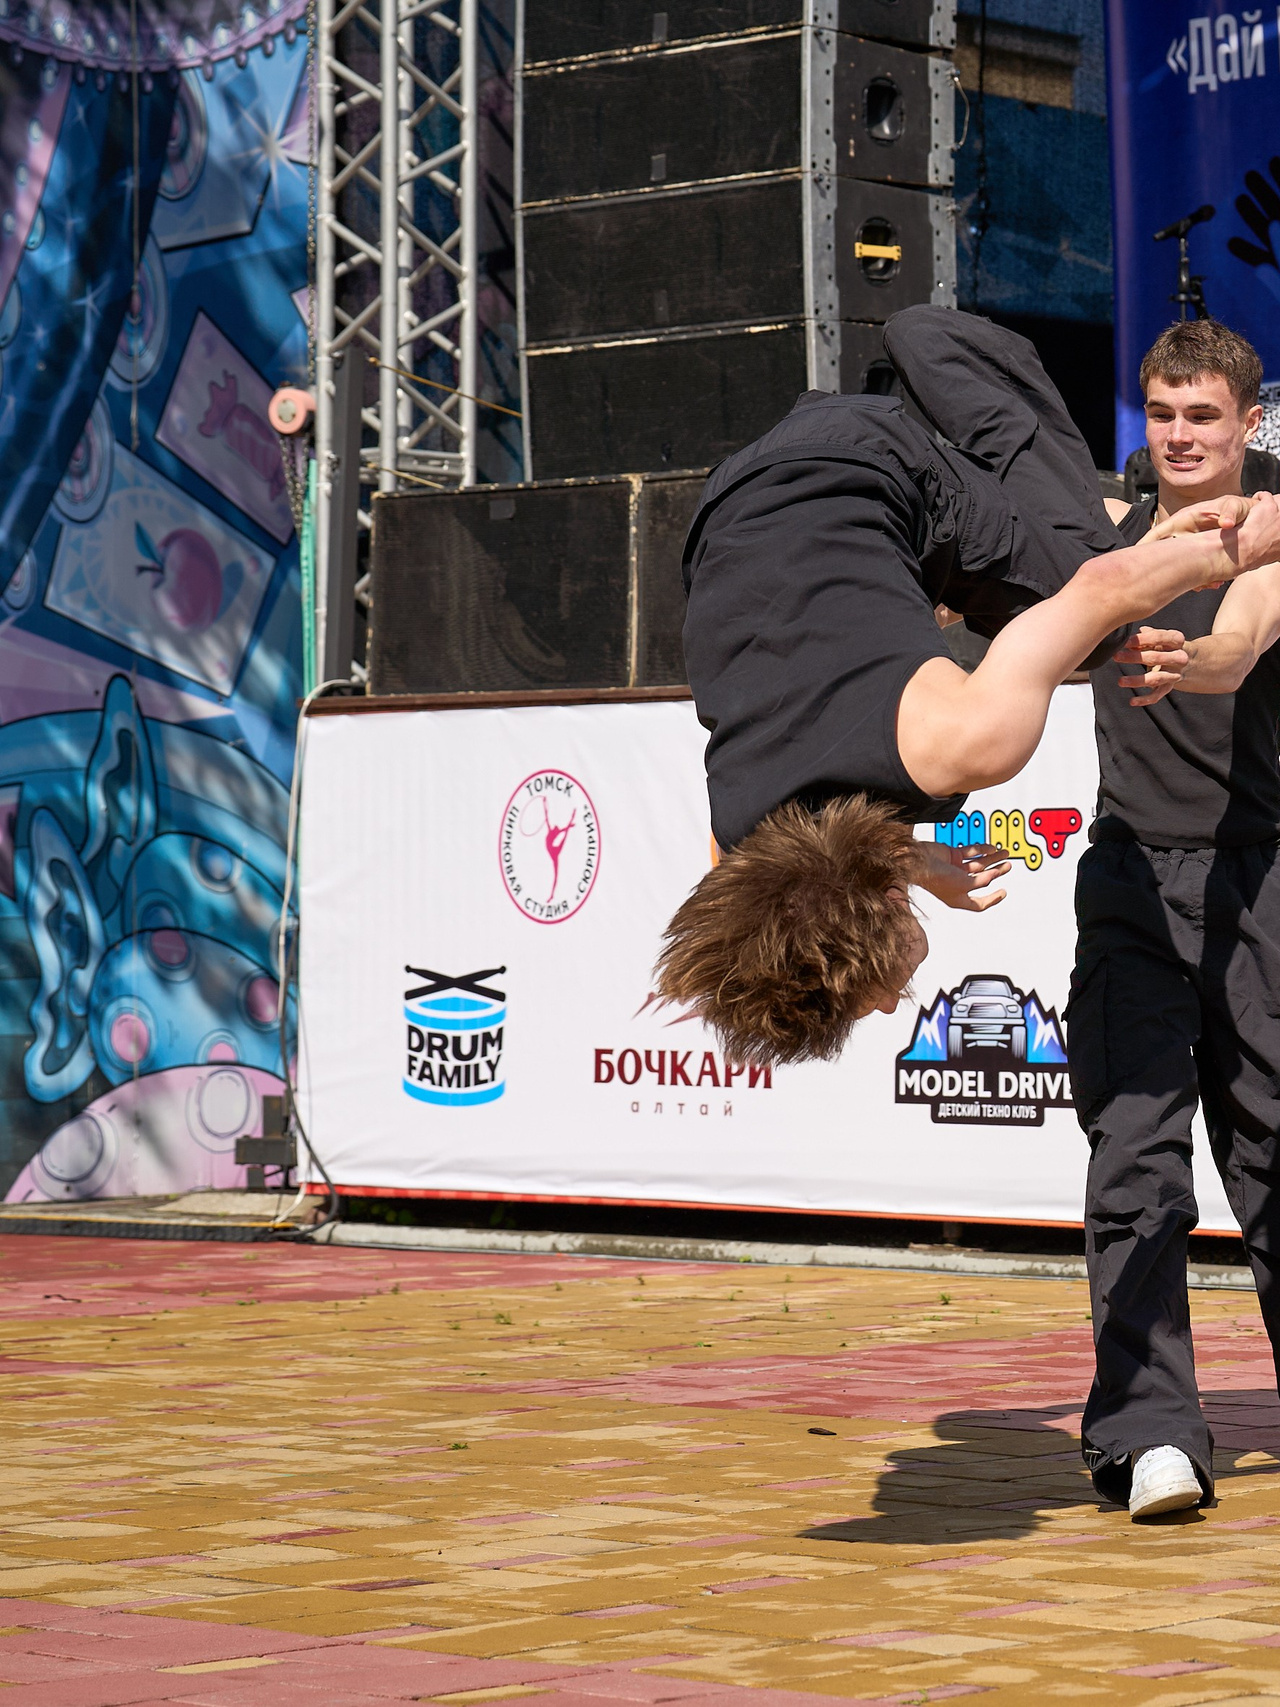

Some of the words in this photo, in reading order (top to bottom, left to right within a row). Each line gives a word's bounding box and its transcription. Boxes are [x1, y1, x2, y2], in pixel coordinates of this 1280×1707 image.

[526, 775, 574, 797] ТОМСК
[503, 805, 523, 896] ЦИРКОВАЯ
[524, 897, 570, 918] СТУДИЯ
[407, 1024, 504, 1062] DRUM
[407, 1053, 502, 1089] FAMILY
[898, 1068, 993, 1099] MODEL
[631, 1100, 733, 1117] алтай
[937, 1101, 981, 1118] ДЕТСКИЙ
[982, 1104, 1011, 1118] ТЕХНО
[1011, 1105, 1037, 1119] КЛУБ
